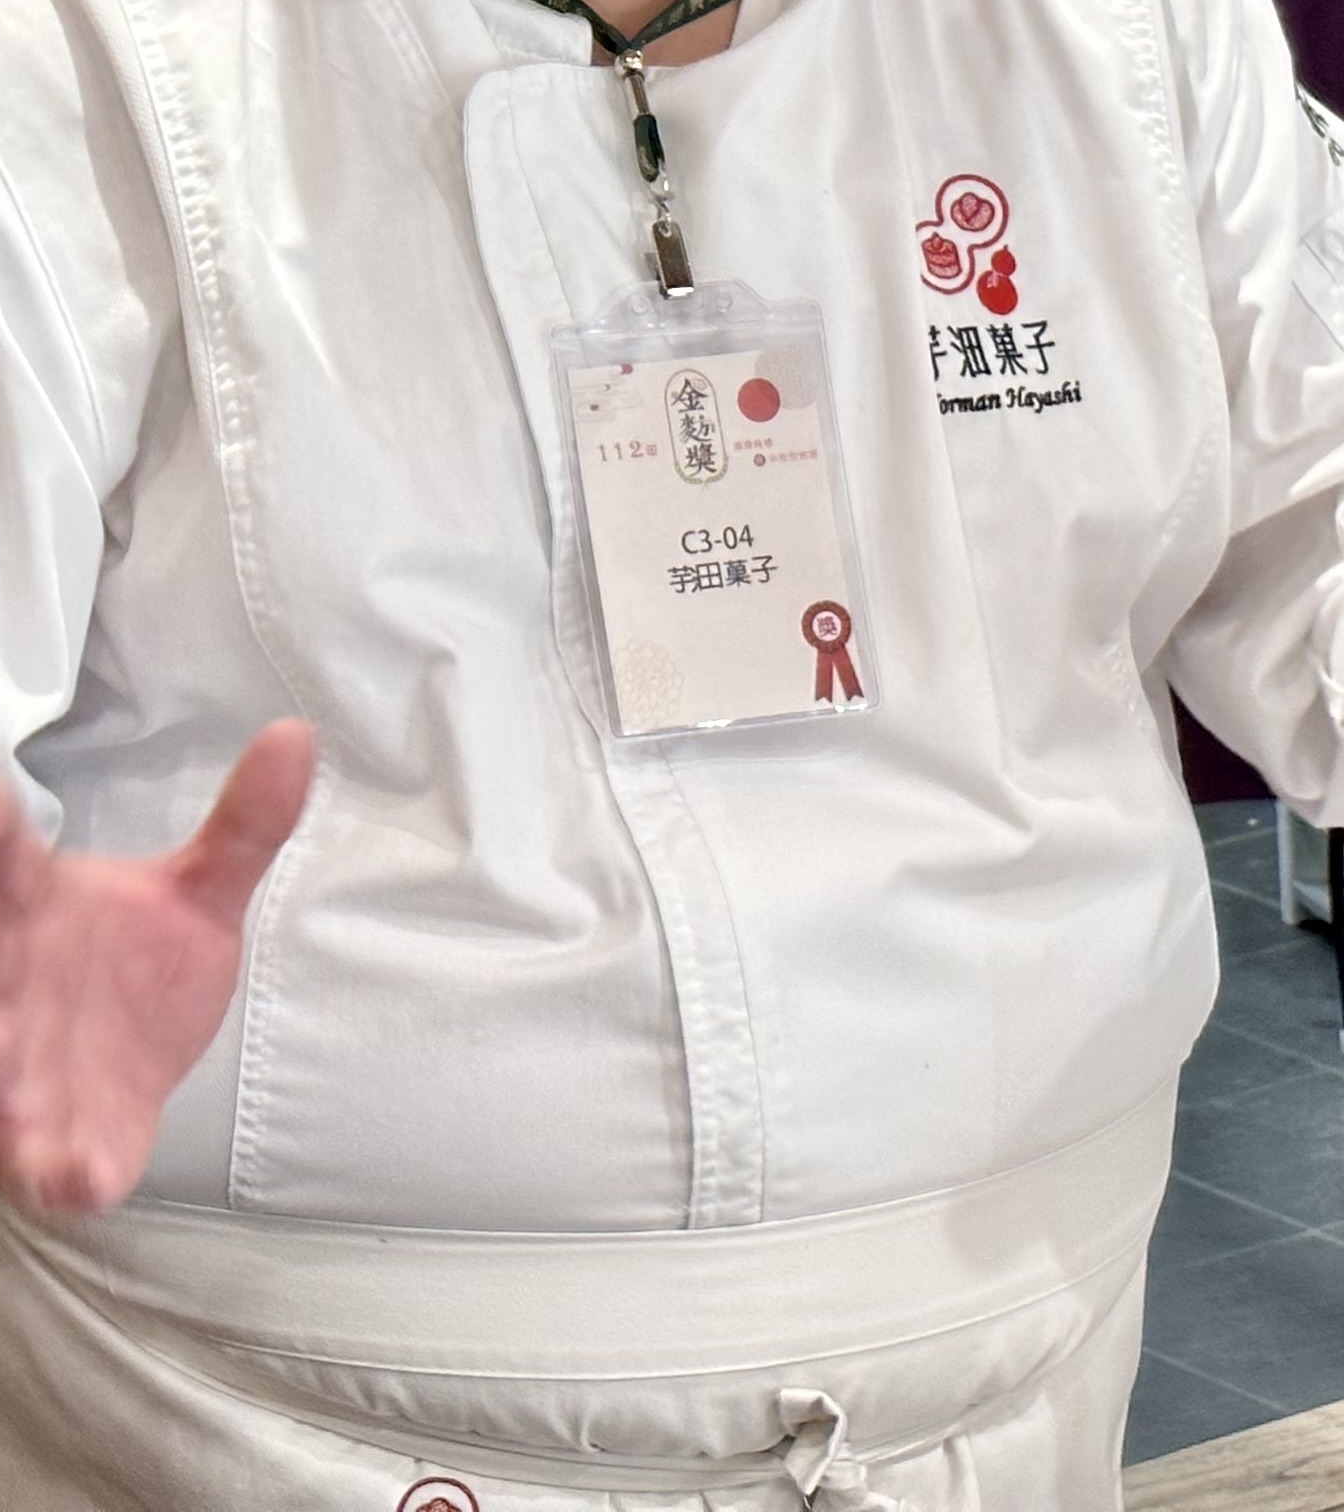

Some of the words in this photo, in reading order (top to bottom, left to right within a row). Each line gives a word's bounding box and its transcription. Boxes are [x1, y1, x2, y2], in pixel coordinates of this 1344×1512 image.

[937, 392, 1001, 415] orman
[1006, 380, 1083, 413] Hayashi
[681, 524, 754, 554] C3-04
